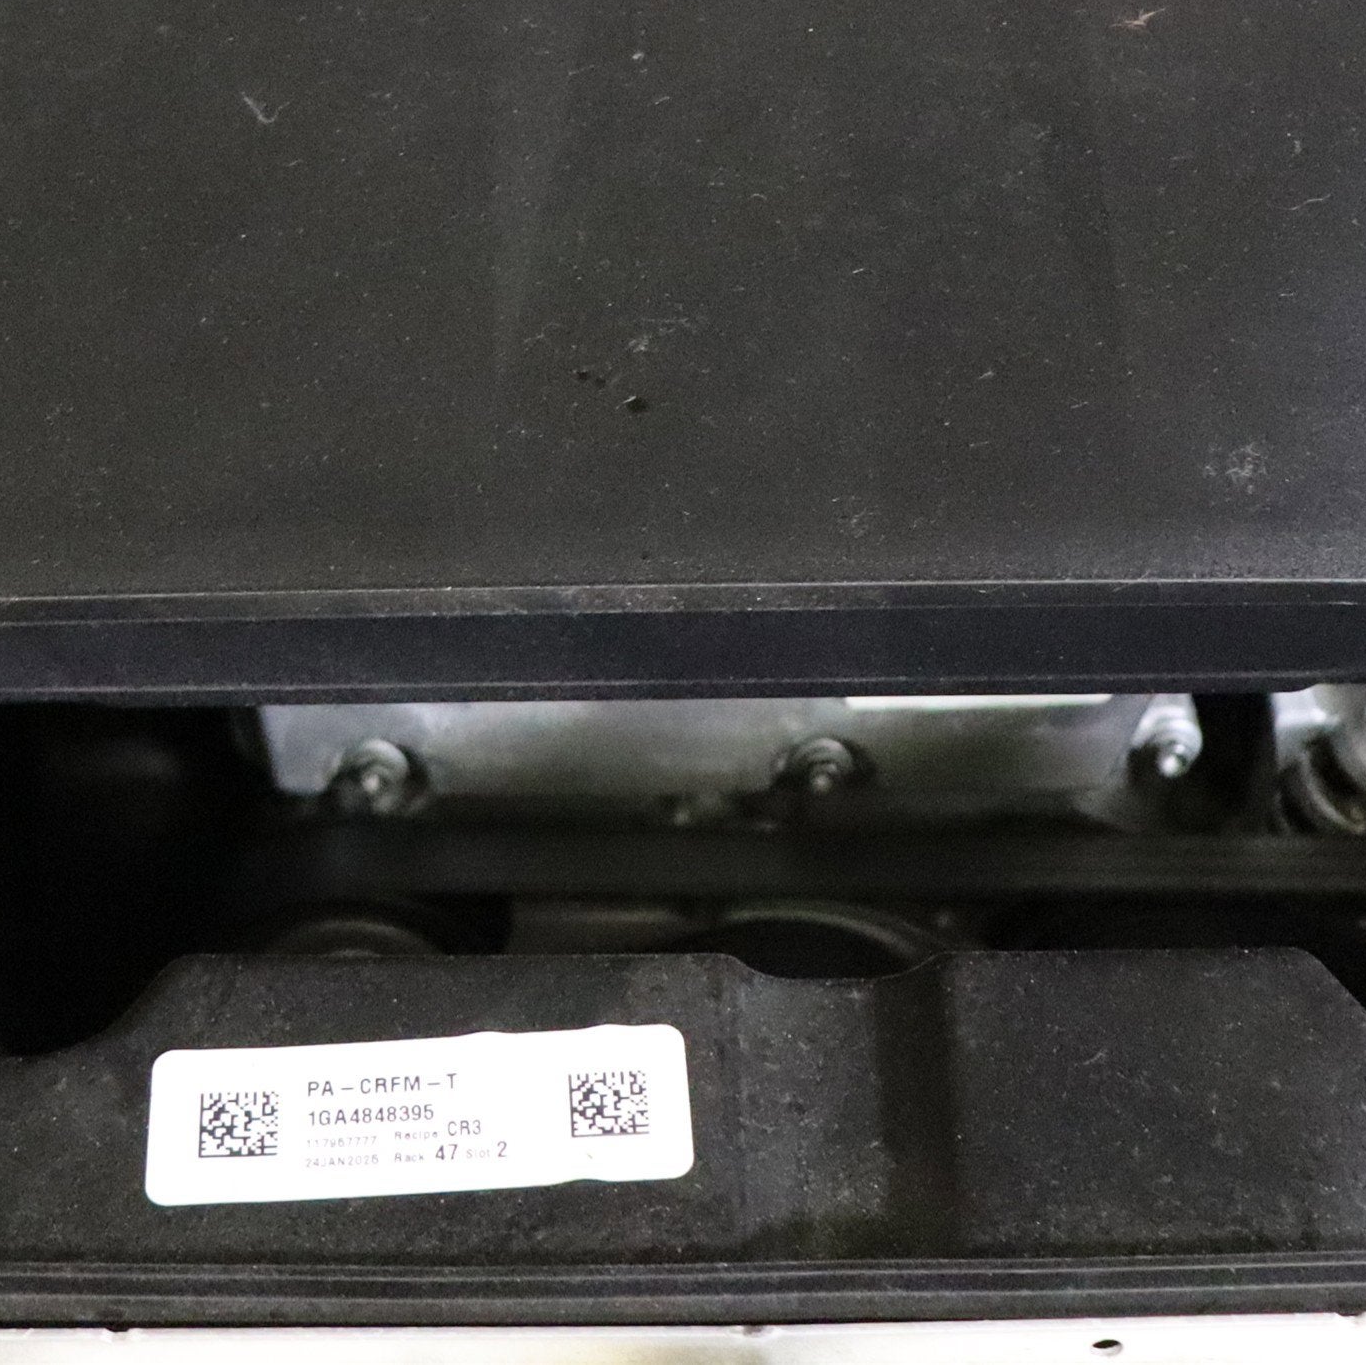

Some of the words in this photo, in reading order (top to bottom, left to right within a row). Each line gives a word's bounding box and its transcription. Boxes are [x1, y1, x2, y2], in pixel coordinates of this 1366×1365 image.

[308, 1103, 435, 1126] 1GA4848395
[394, 1131, 438, 1141] Recipe
[447, 1119, 482, 1137] CR3
[394, 1152, 424, 1162] Rack
[435, 1143, 458, 1161] 47
[466, 1149, 491, 1160] Slot
[496, 1140, 508, 1158] 2
